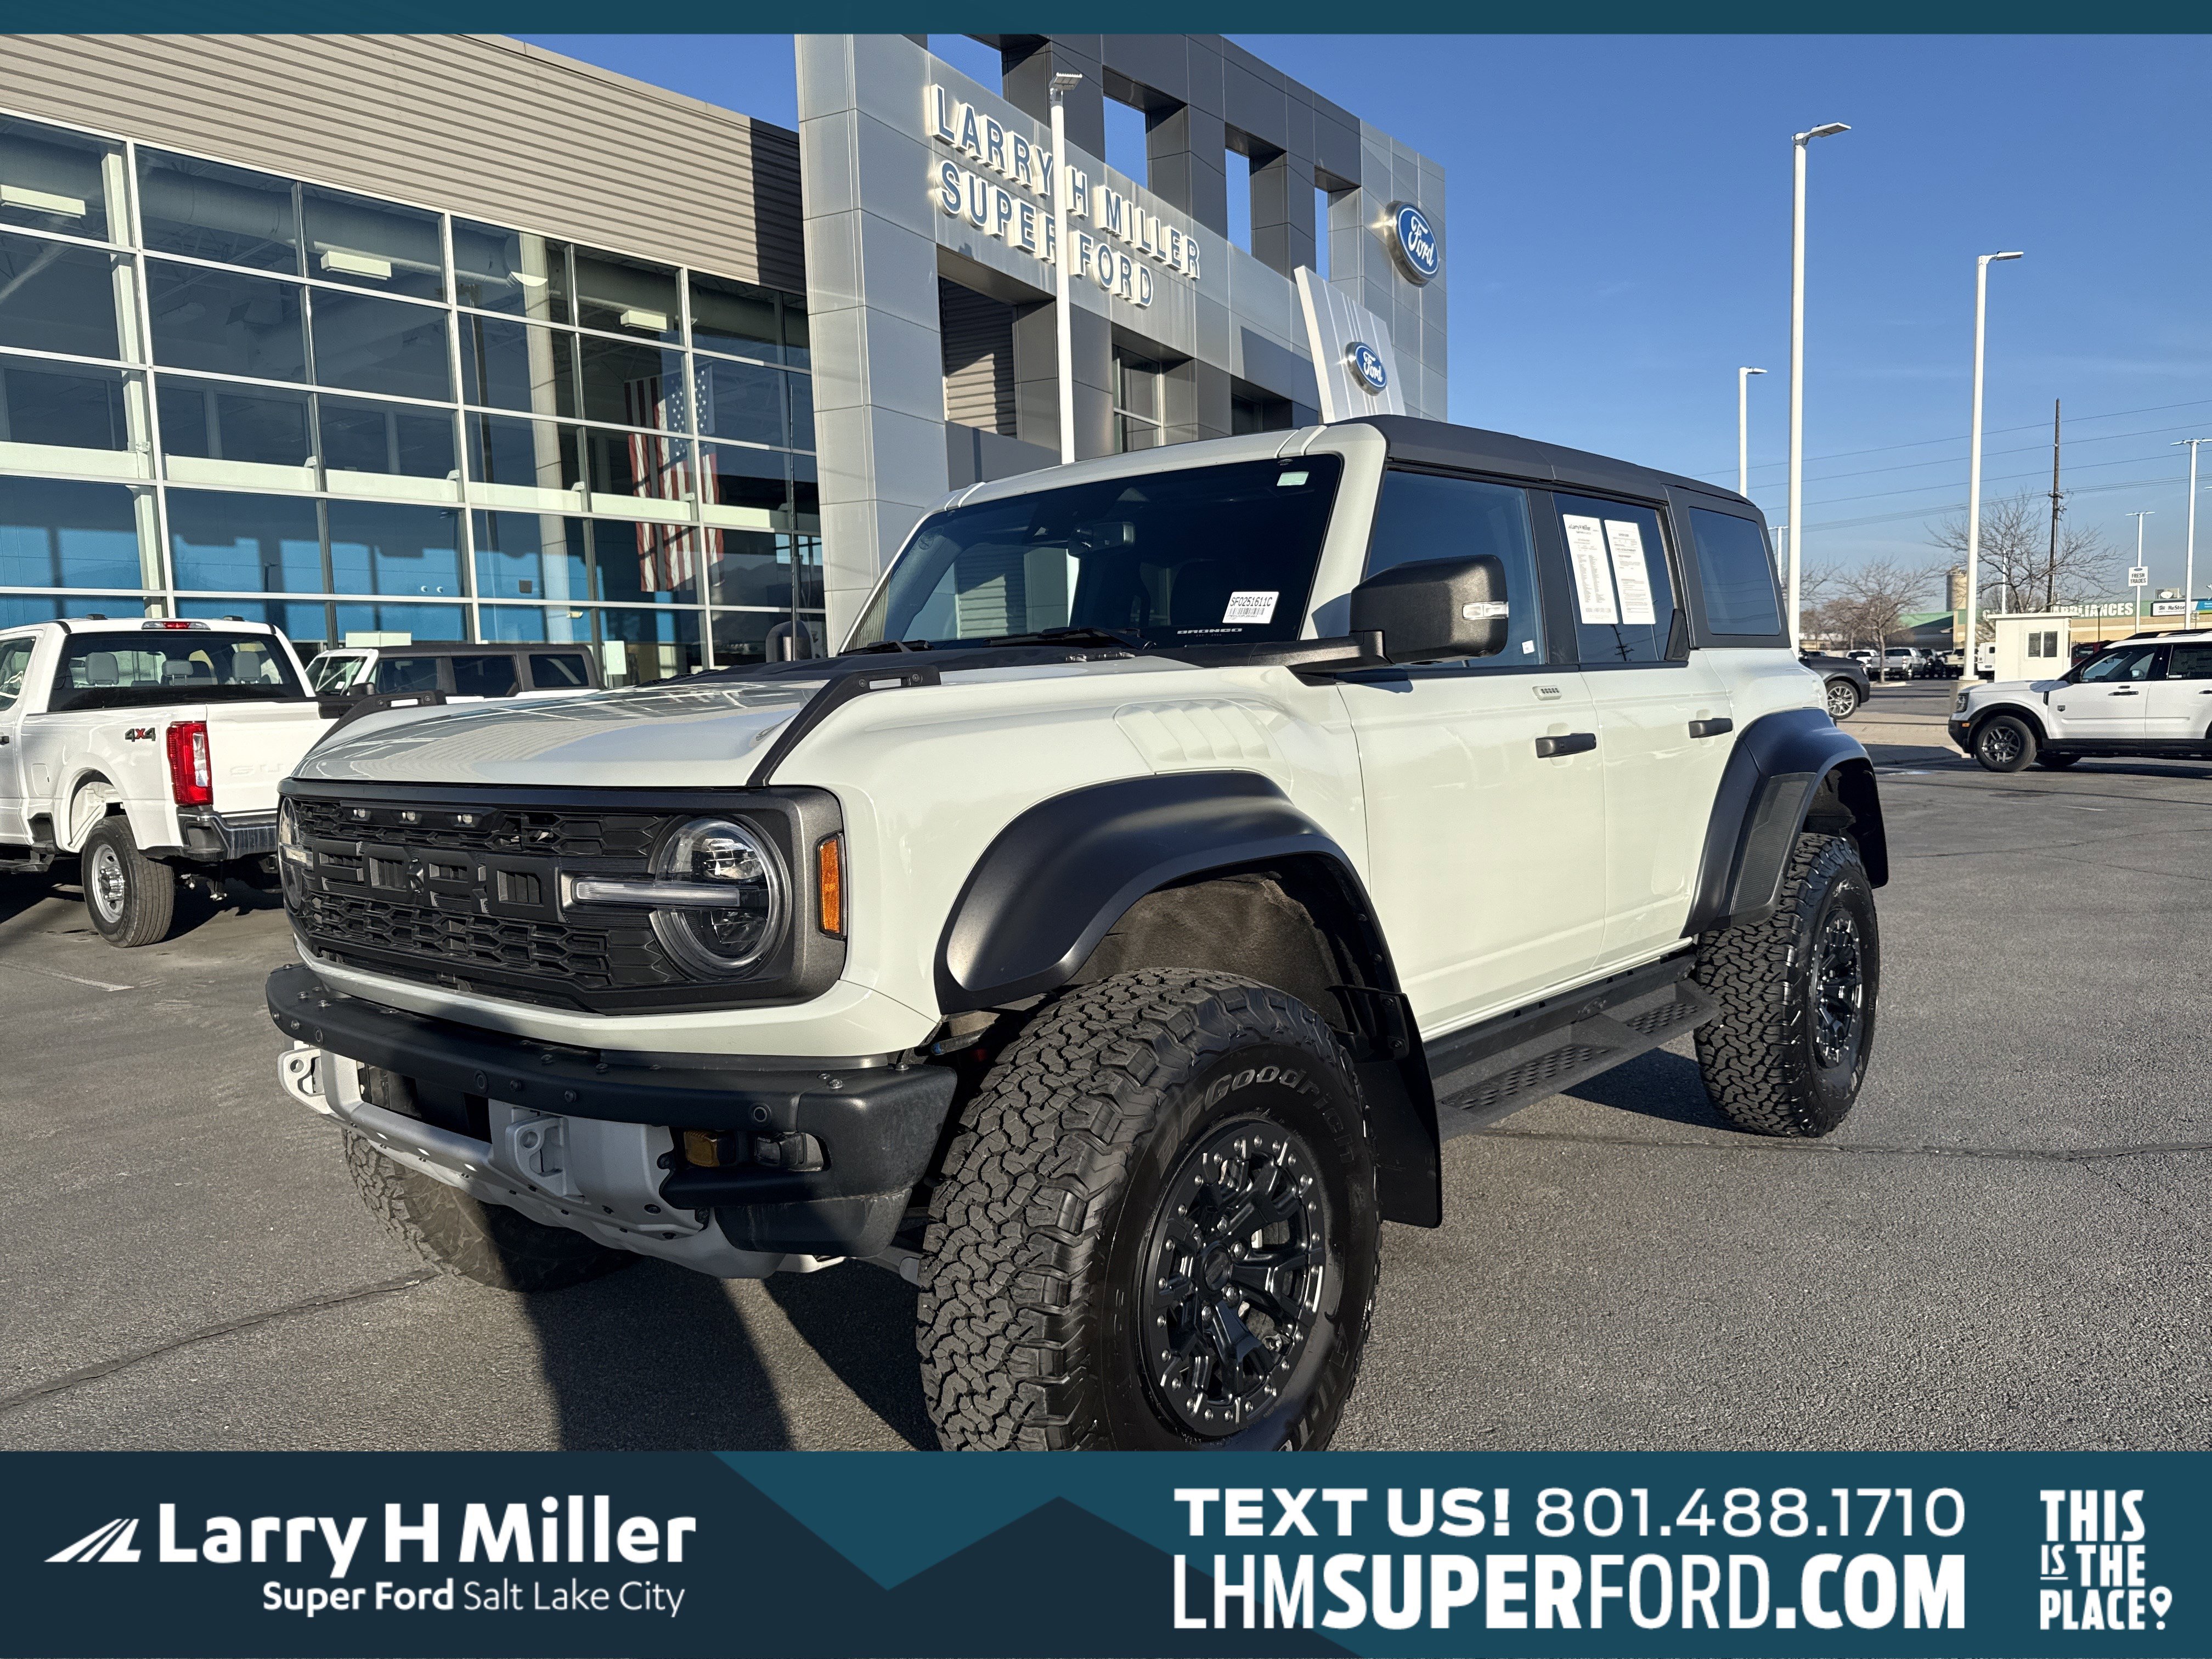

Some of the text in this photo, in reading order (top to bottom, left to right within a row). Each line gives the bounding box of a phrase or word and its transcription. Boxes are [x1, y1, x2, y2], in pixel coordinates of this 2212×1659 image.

[931, 83, 1200, 279] LARRY H MILLER
[1069, 229, 1154, 307] FORD
[1408, 216, 1435, 267] Ford
[1363, 351, 1383, 383] Ford
